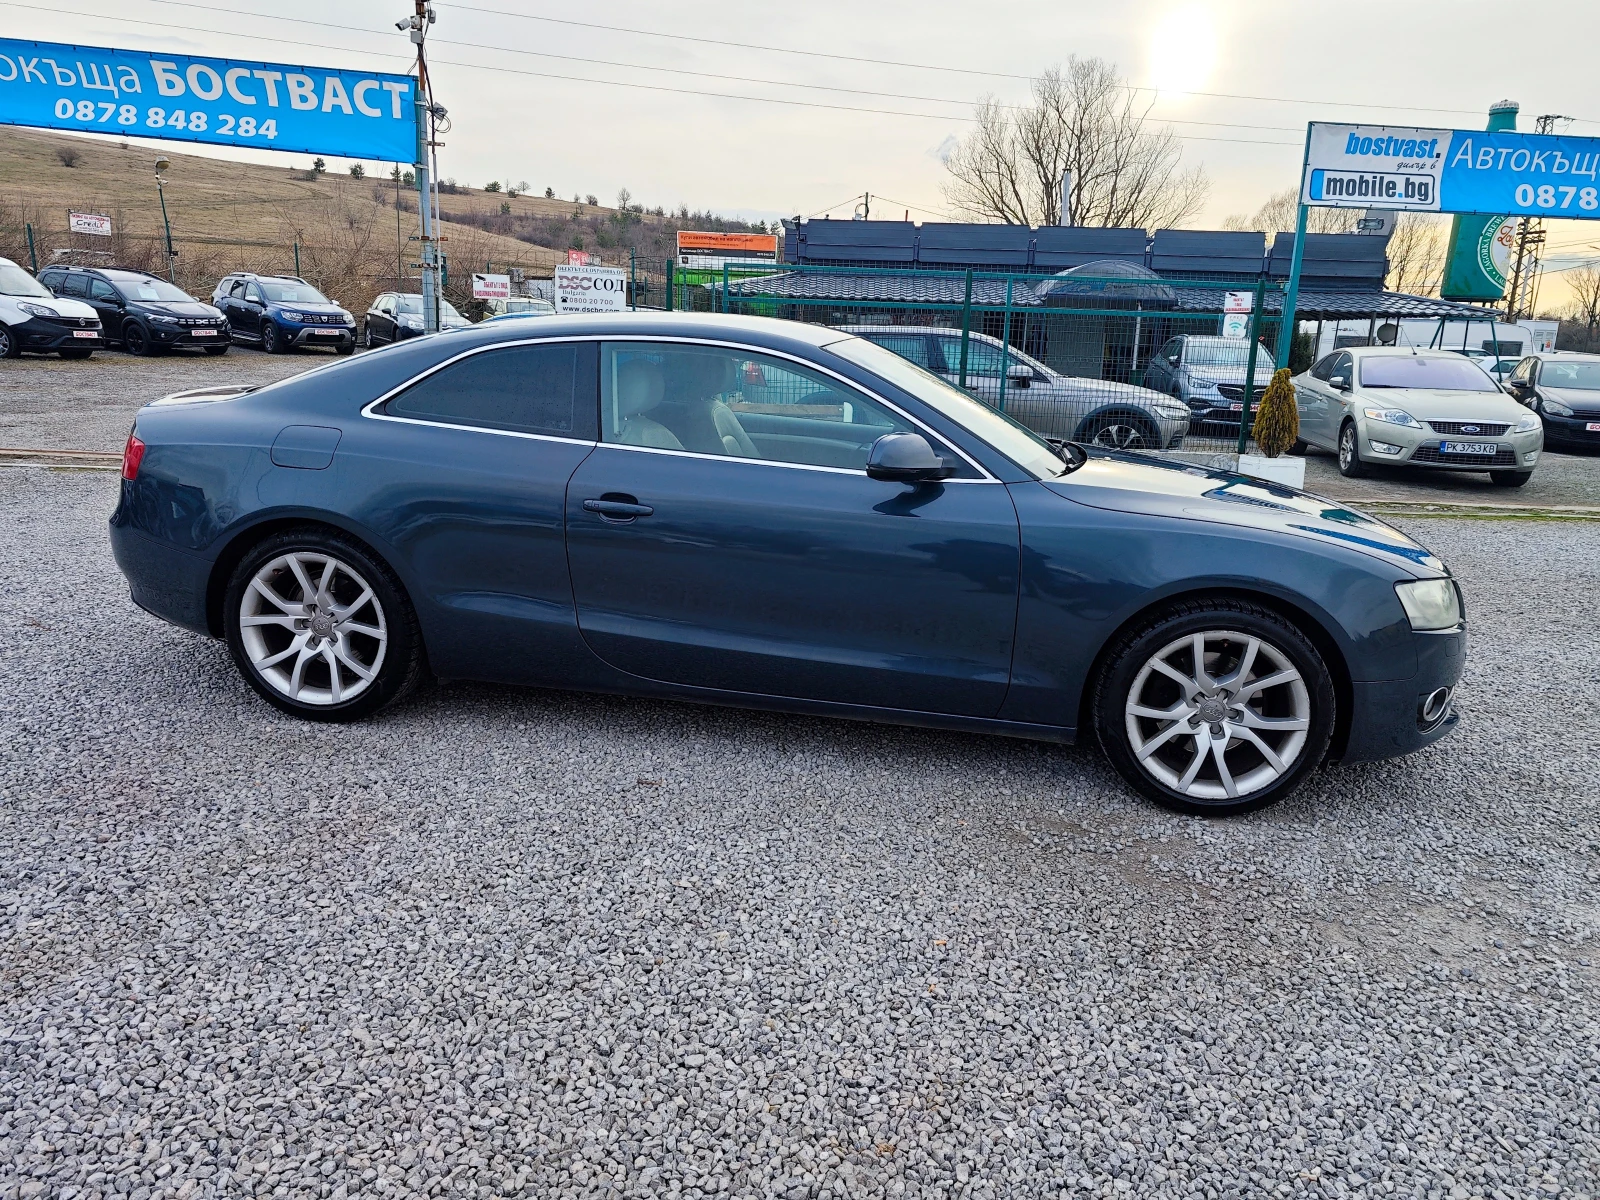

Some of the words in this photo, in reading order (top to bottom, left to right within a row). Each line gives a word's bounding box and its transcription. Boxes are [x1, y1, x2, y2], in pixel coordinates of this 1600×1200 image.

[149, 59, 410, 119] БОСТВАСТ
[54, 98, 138, 126] 0878
[145, 107, 208, 132] 848
[215, 114, 279, 140] 284
[1450, 138, 1600, 182] Автокъщ
[1325, 175, 1430, 202] mobile.bg
[1515, 183, 1599, 211] 0878
[1481, 238, 1493, 272] ZAGORKA
[558, 275, 593, 291] DSC
[593, 277, 625, 294] СОД
[599, 298, 614, 306] 700
[1460, 444, 1482, 453] 3753
